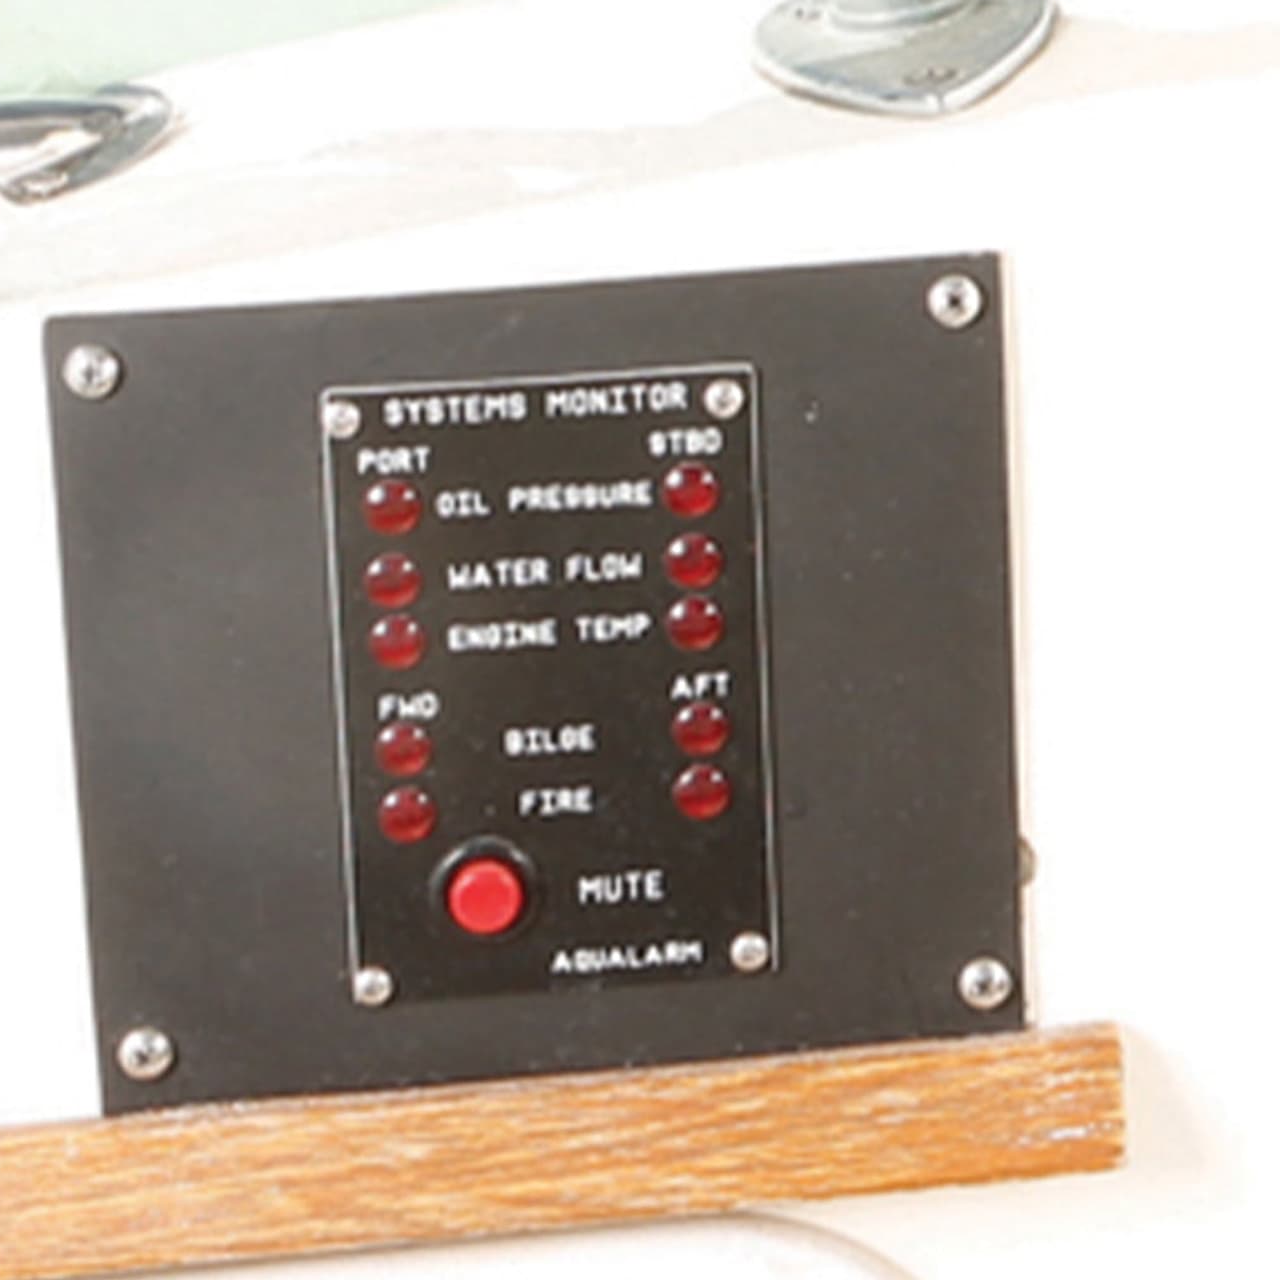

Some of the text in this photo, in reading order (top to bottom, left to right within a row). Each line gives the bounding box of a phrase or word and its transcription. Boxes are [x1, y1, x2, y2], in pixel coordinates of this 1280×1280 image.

[383, 380, 689, 426] SYSTEMS MONITOR
[648, 426, 722, 456] STBD
[357, 446, 430, 475] PORT
[436, 481, 652, 517] OIL PRESSURE
[447, 553, 642, 589] WATER FLOW
[447, 613, 651, 651] ENGINE TEMP
[671, 671, 729, 698] AFT
[378, 691, 439, 719] FWD
[505, 724, 593, 755] BILGE
[520, 787, 591, 814] FIRE
[579, 870, 662, 902] MUTE
[552, 941, 702, 972] AQUALARM
